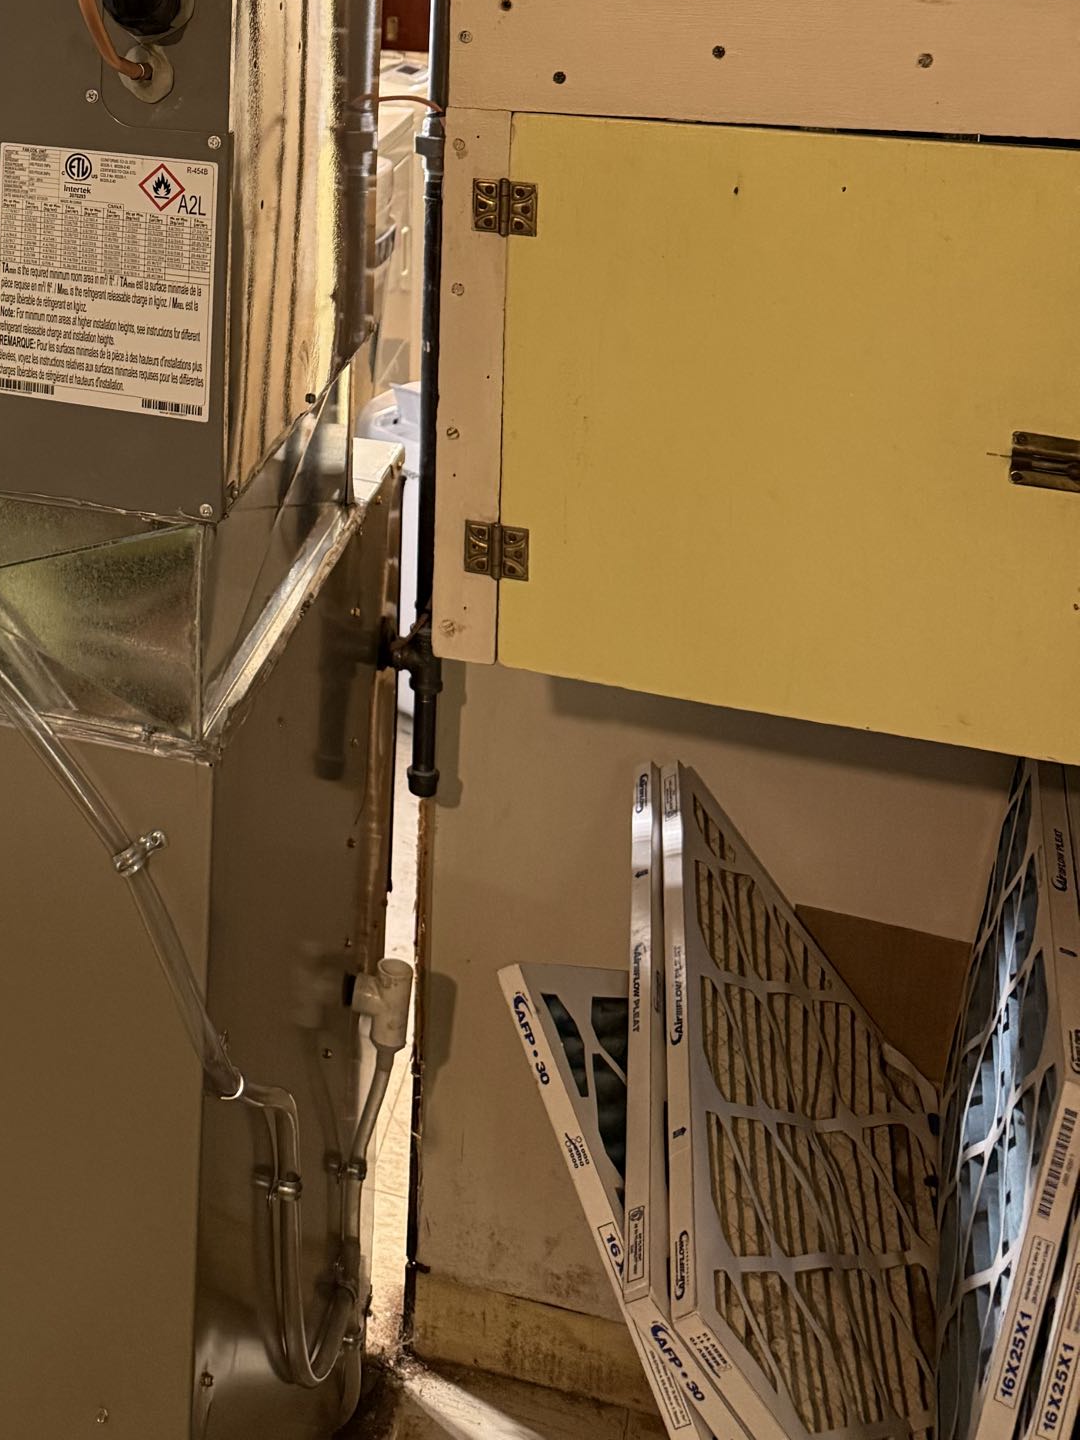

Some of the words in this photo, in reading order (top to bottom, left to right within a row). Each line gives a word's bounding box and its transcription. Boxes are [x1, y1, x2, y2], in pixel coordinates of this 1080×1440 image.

[187, 167, 208, 175] R-454B
[64, 185, 91, 194] Intertek
[178, 194, 206, 216] A2L
[0, 305, 15, 317] Note:
[0, 334, 36, 349] REMARQUE:
[515, 1010, 535, 1045] AFP
[536, 1061, 550, 1085] 30
[1001, 1311, 1032, 1397] 16X25X1
[655, 1338, 682, 1368] AFP
[686, 1381, 705, 1400] 30
[1044, 1342, 1074, 1431] 16X25X1
